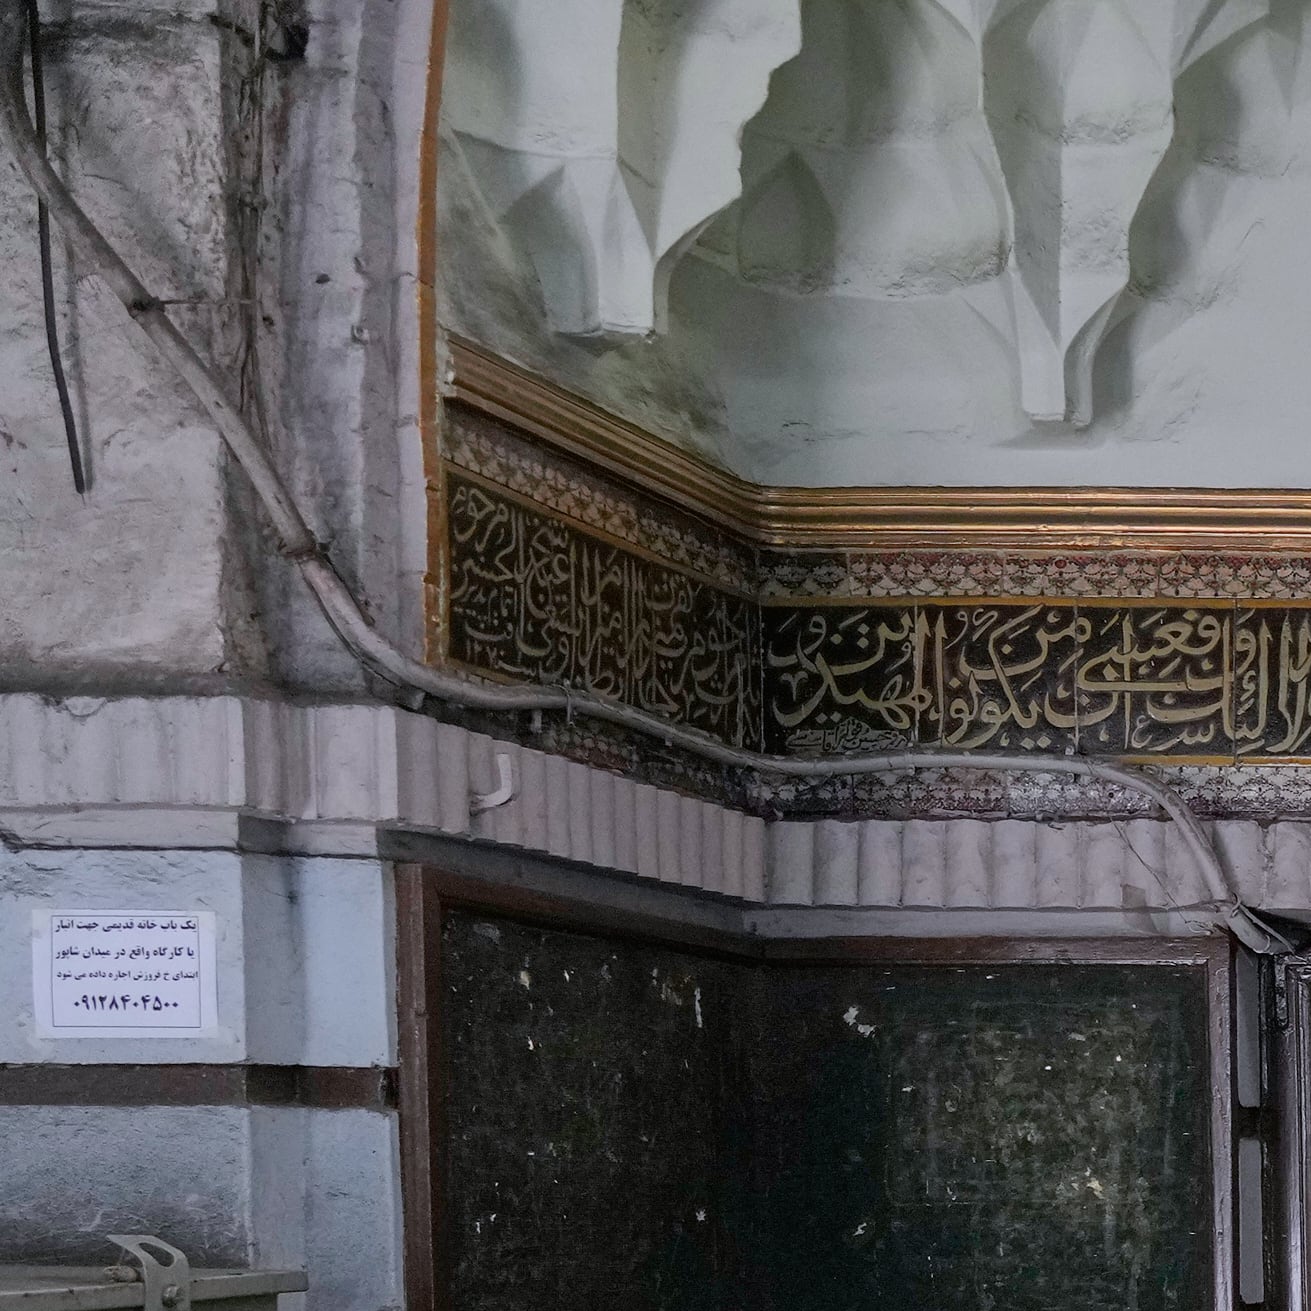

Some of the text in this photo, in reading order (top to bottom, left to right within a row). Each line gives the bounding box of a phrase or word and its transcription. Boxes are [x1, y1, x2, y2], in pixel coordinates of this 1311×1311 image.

[55, 918, 198, 933] یک باب خانه قدیمی جهت انبار
[55, 945, 79, 960] شاپور
[82, 945, 112, 960] میدان
[114, 947, 126, 960] در
[128, 945, 151, 960] واقع
[185, 945, 196, 960] یا
[56, 970, 73, 981] شود
[74, 972, 87, 981] می
[88, 970, 107, 979] داده
[108, 970, 131, 981] اجاره
[171, 970, 199, 981] ابتدای
[73, 994, 179, 1012] ۰۹۱۲۸۴۰۴۵۰۰
